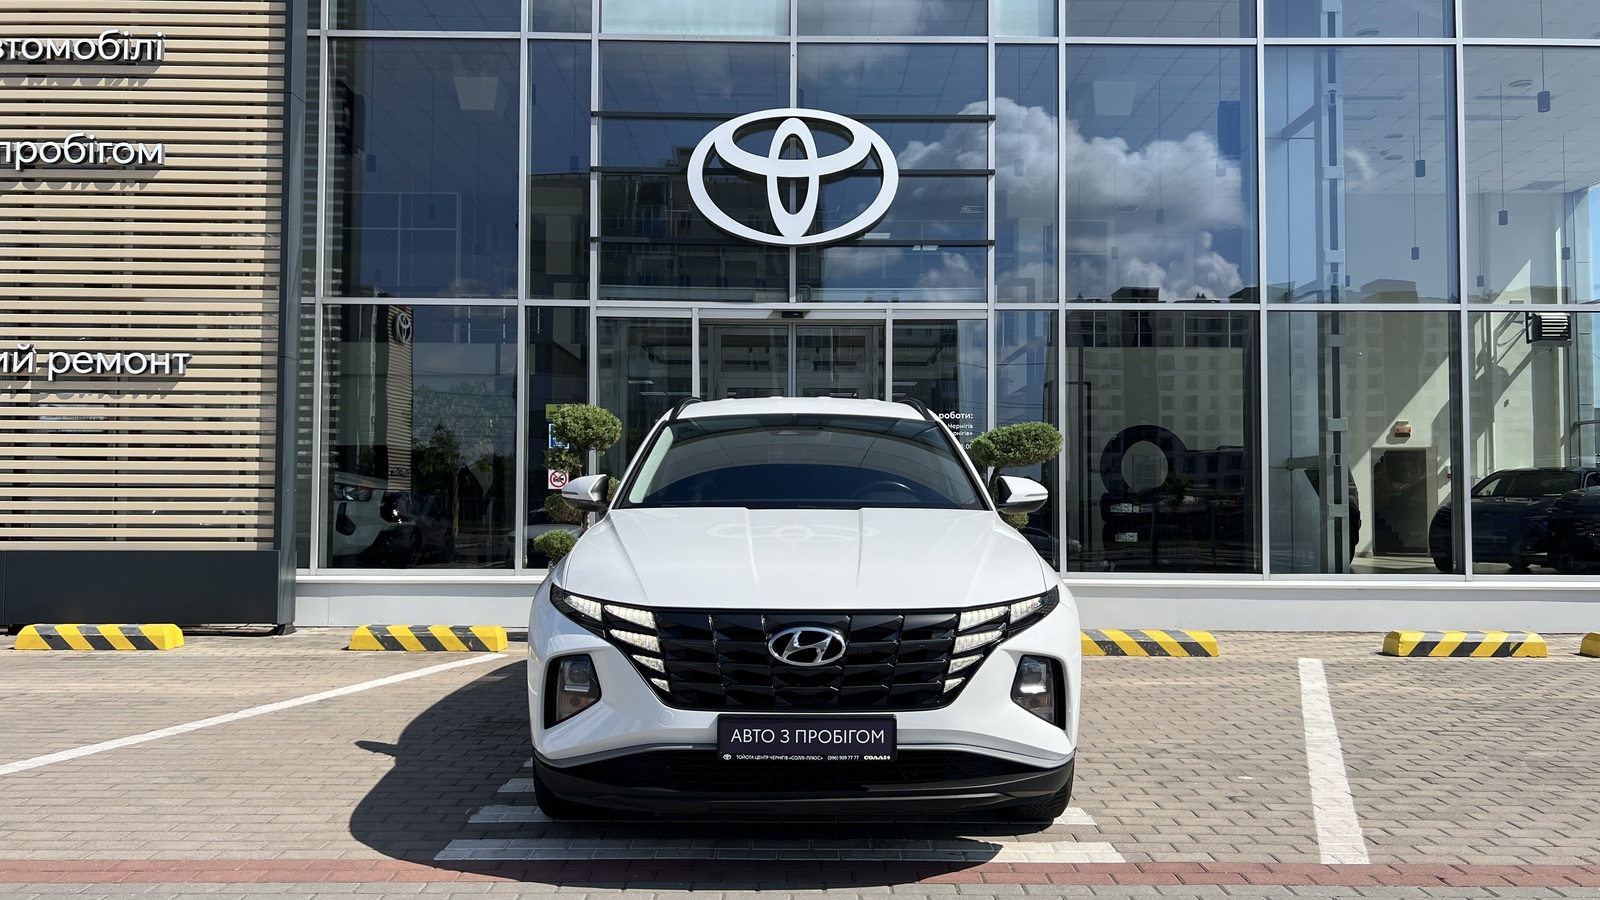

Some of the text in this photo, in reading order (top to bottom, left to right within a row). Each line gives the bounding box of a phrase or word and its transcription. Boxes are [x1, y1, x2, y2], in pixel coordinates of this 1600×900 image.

[0, 29, 165, 61] томобілі
[48, 351, 191, 381] ремонт
[938, 411, 974, 420] роботи:
[730, 728, 885, 744] АВТО З ПРОБІГОМ
